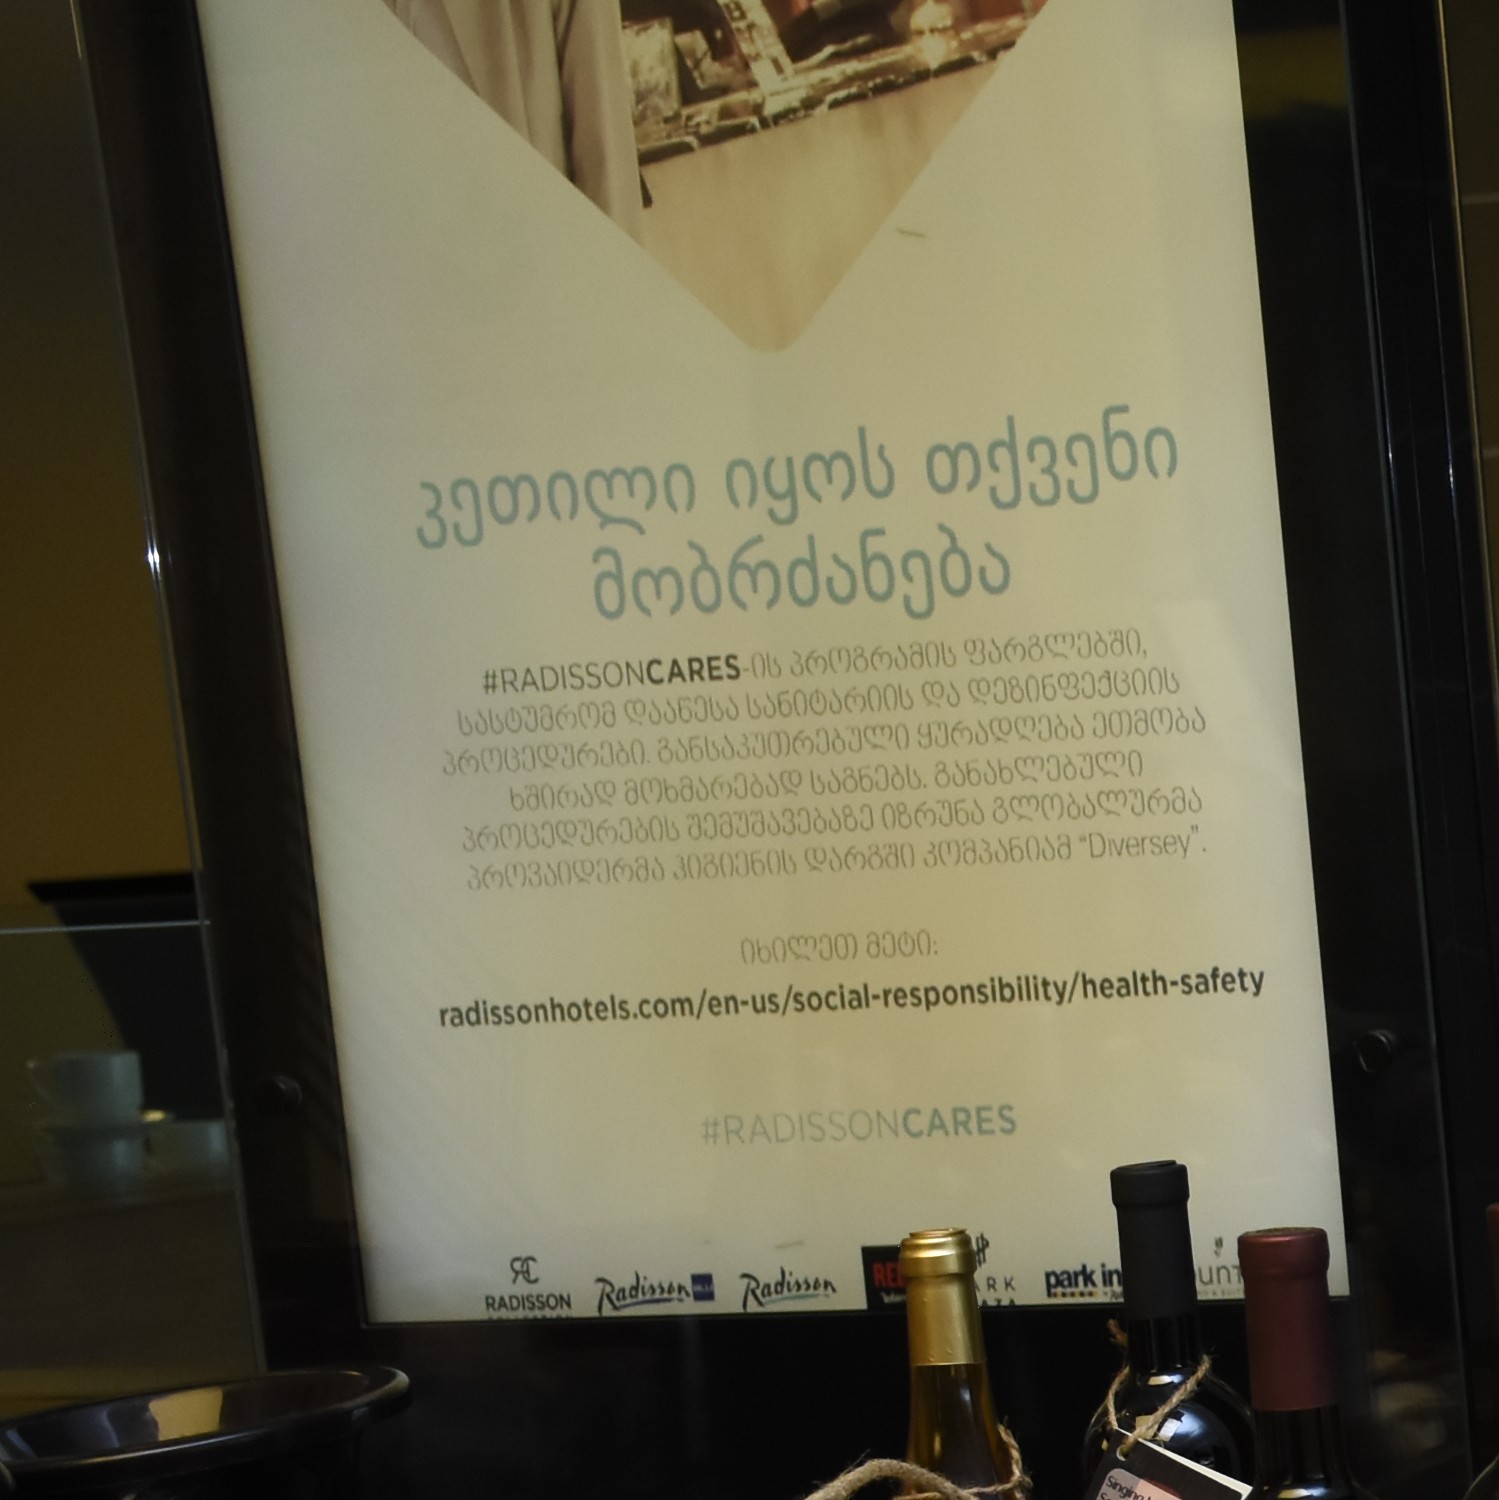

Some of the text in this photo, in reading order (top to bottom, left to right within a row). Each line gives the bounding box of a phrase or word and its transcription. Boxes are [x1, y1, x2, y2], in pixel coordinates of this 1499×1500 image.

[415, 405, 1179, 548] კეთილი იყოს თქვენი
[593, 523, 1012, 619] მობრძანება
[438, 965, 1265, 1028] radissonhotels.com/en-us/social-responsibility/health-safety
[702, 1103, 1018, 1145] #RADISSONCARES
[486, 1293, 571, 1312] RADISSON
[595, 1271, 691, 1315] Radisson
[740, 1267, 837, 1311] Radisson
[1045, 1264, 1097, 1297] park
